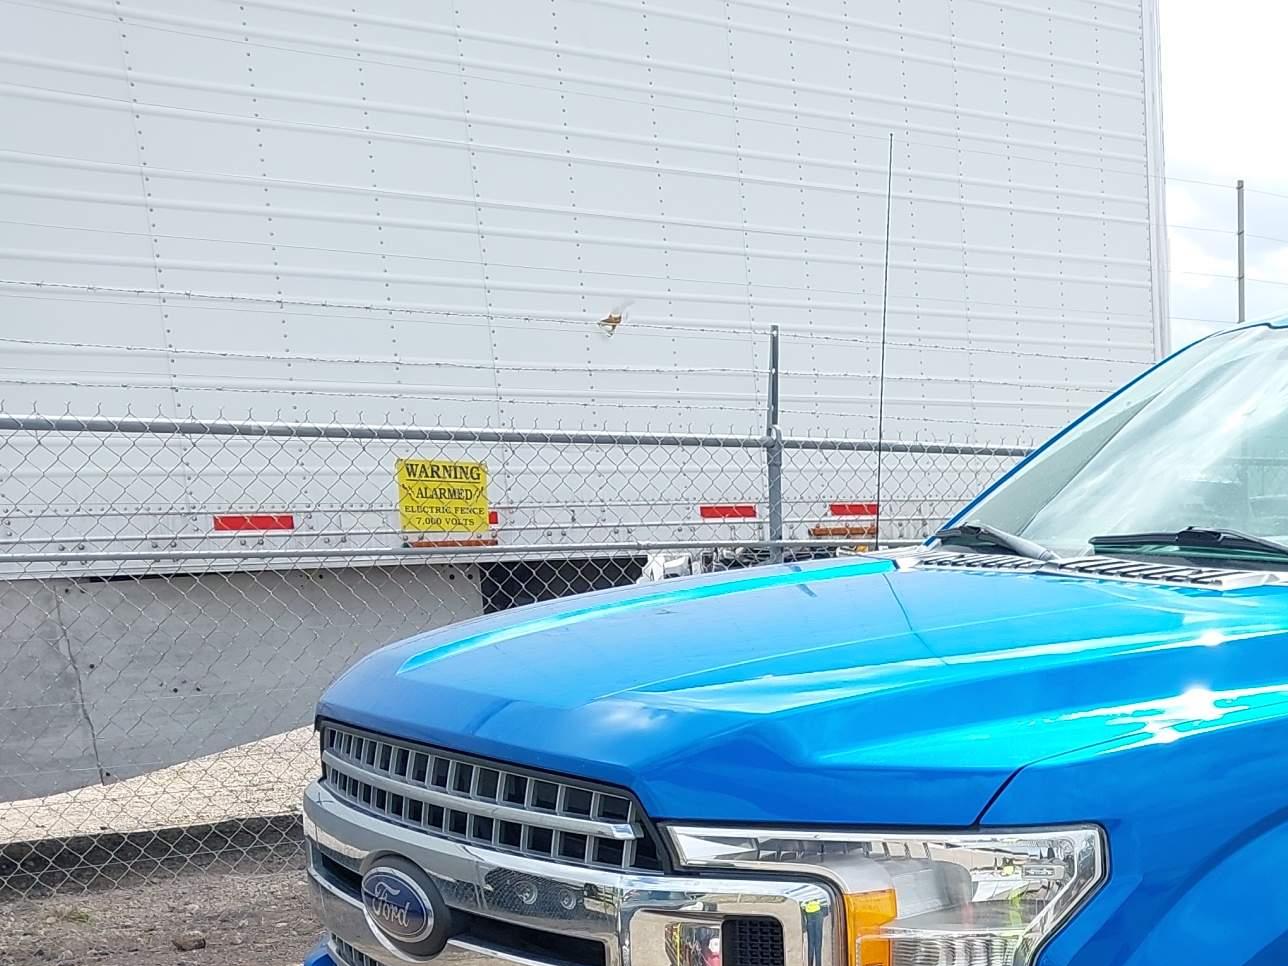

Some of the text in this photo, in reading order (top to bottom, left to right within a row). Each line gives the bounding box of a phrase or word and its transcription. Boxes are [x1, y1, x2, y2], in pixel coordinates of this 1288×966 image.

[405, 463, 481, 481] WARNING
[416, 487, 473, 501] ALARMED
[404, 505, 485, 515] ELECTRIC FENCE
[445, 518, 475, 526] VOLTS
[371, 881, 411, 928] Ford
